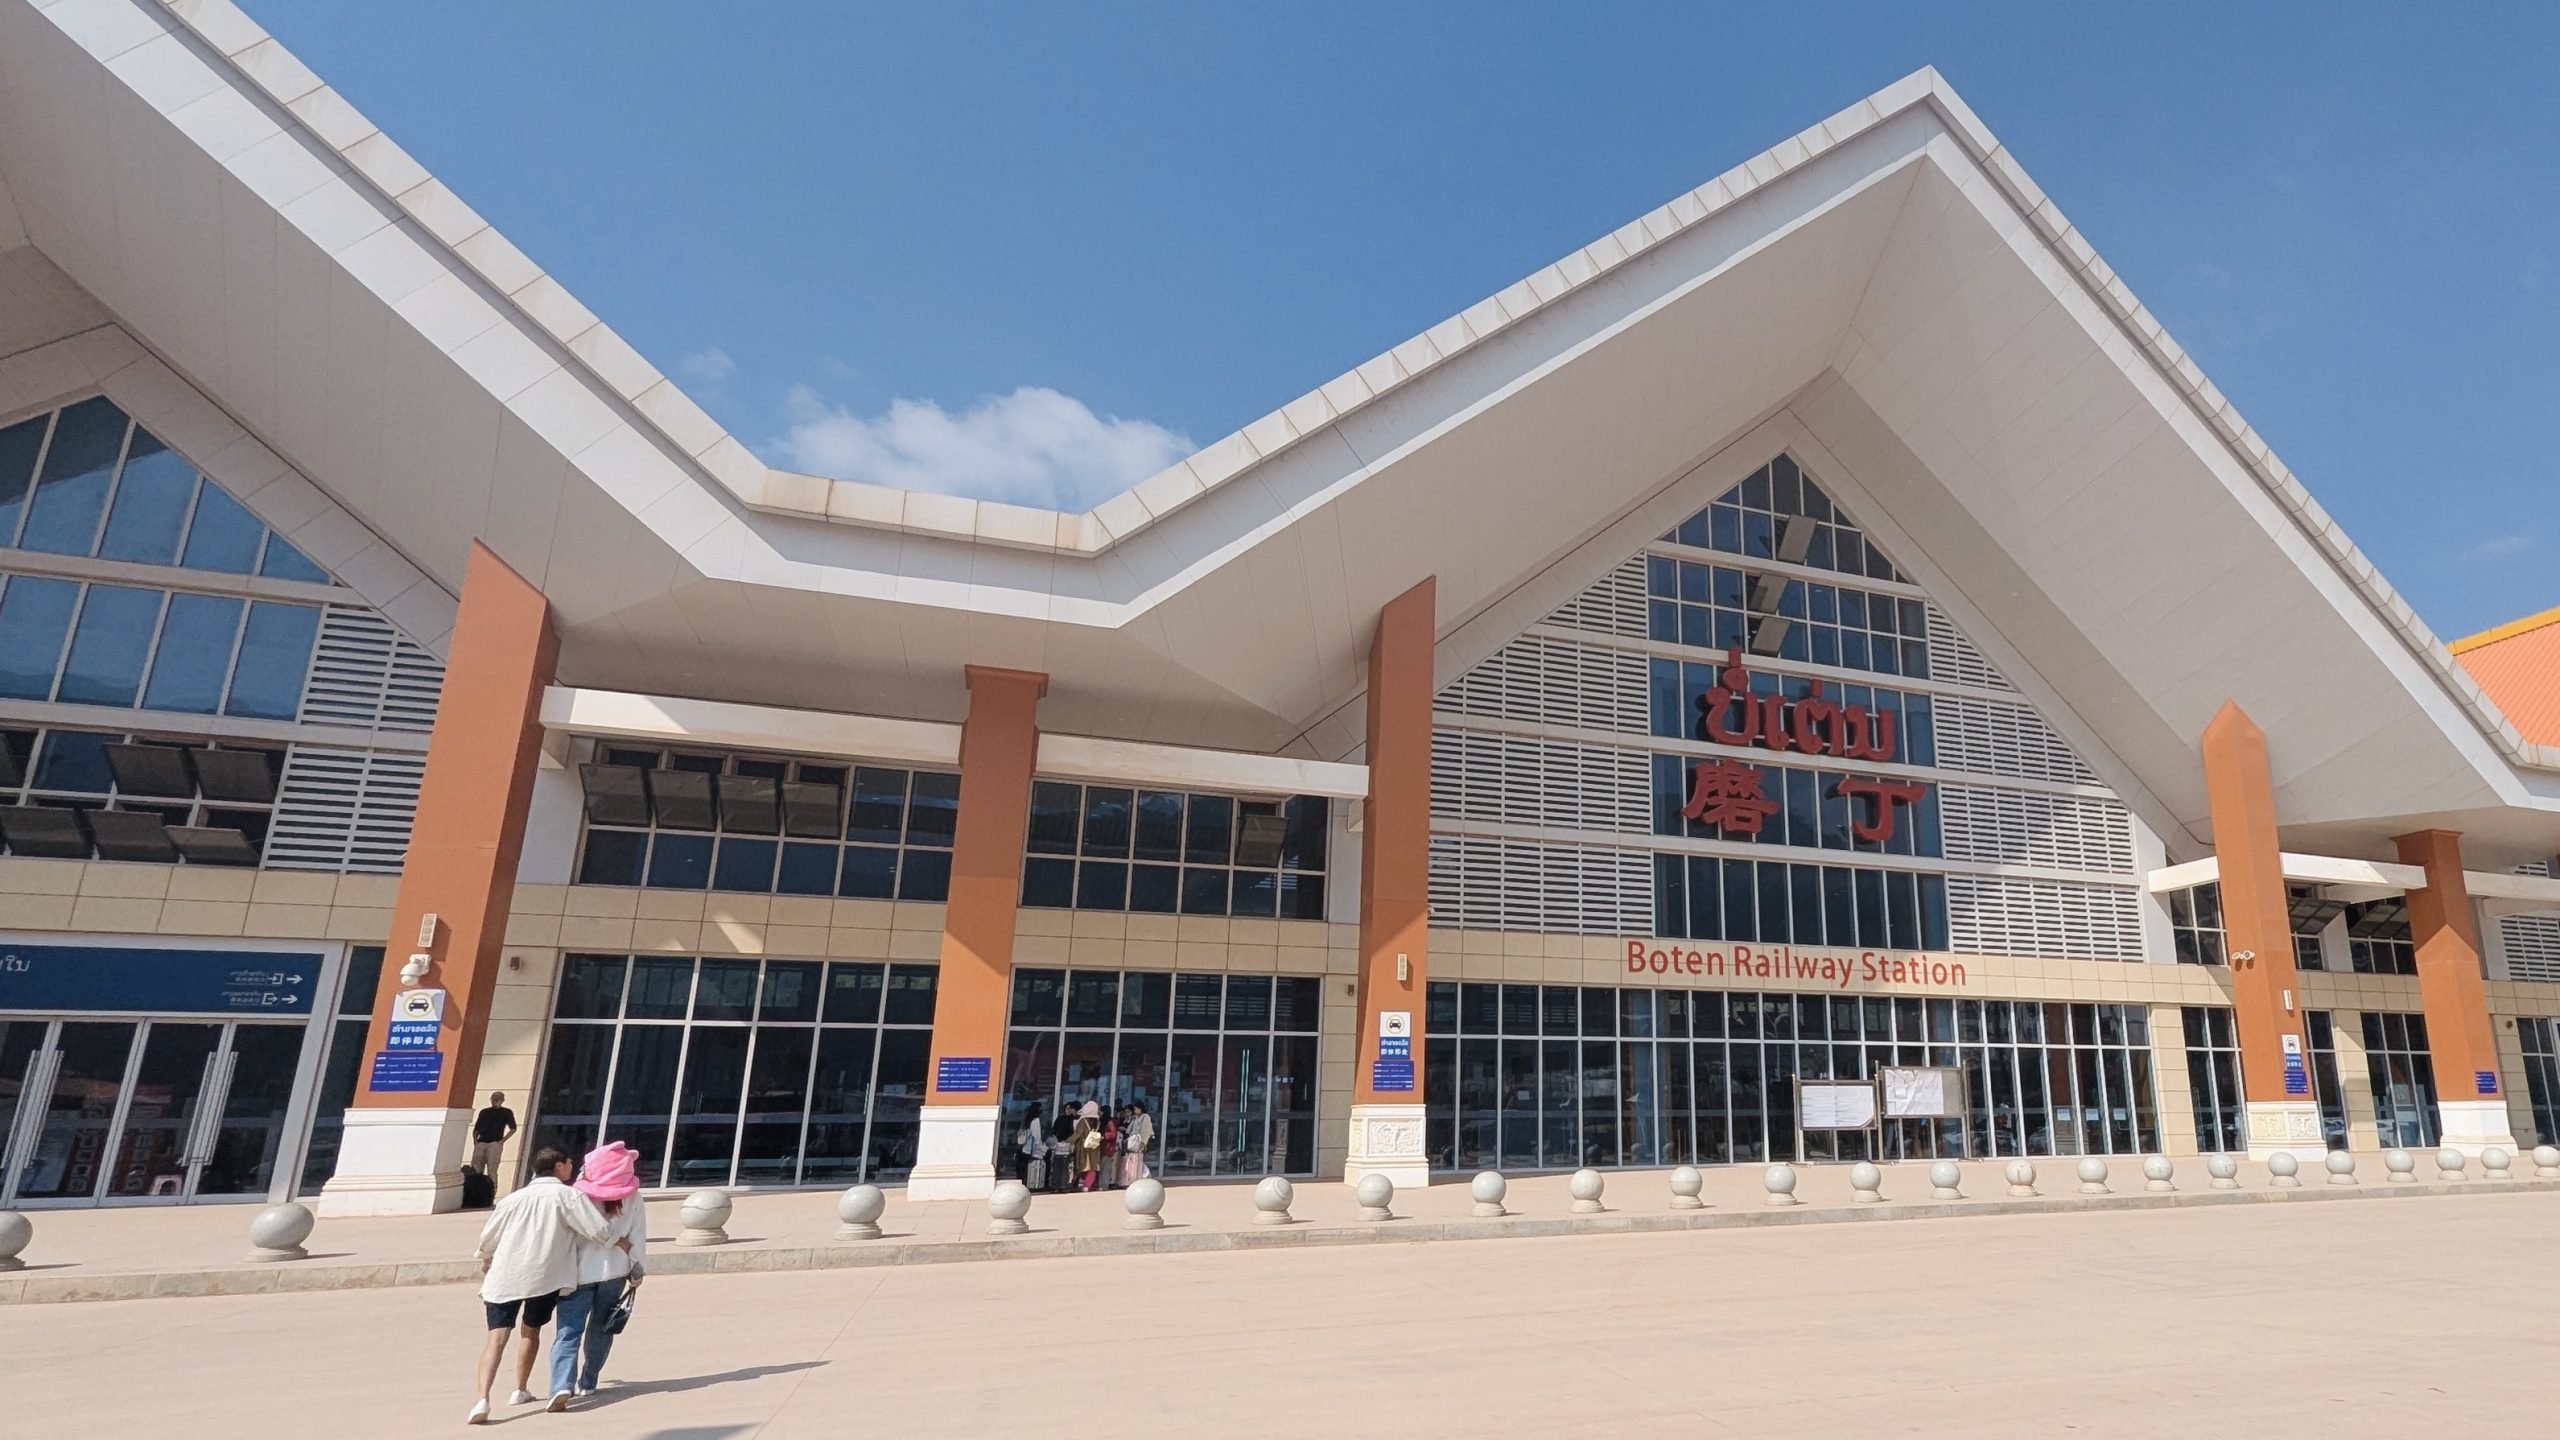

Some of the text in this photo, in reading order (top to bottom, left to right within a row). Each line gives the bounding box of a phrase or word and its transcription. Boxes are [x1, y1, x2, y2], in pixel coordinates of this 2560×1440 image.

[1681, 758, 1926, 841] 磨丁
[1627, 940, 1967, 988] Boten Railway Station
